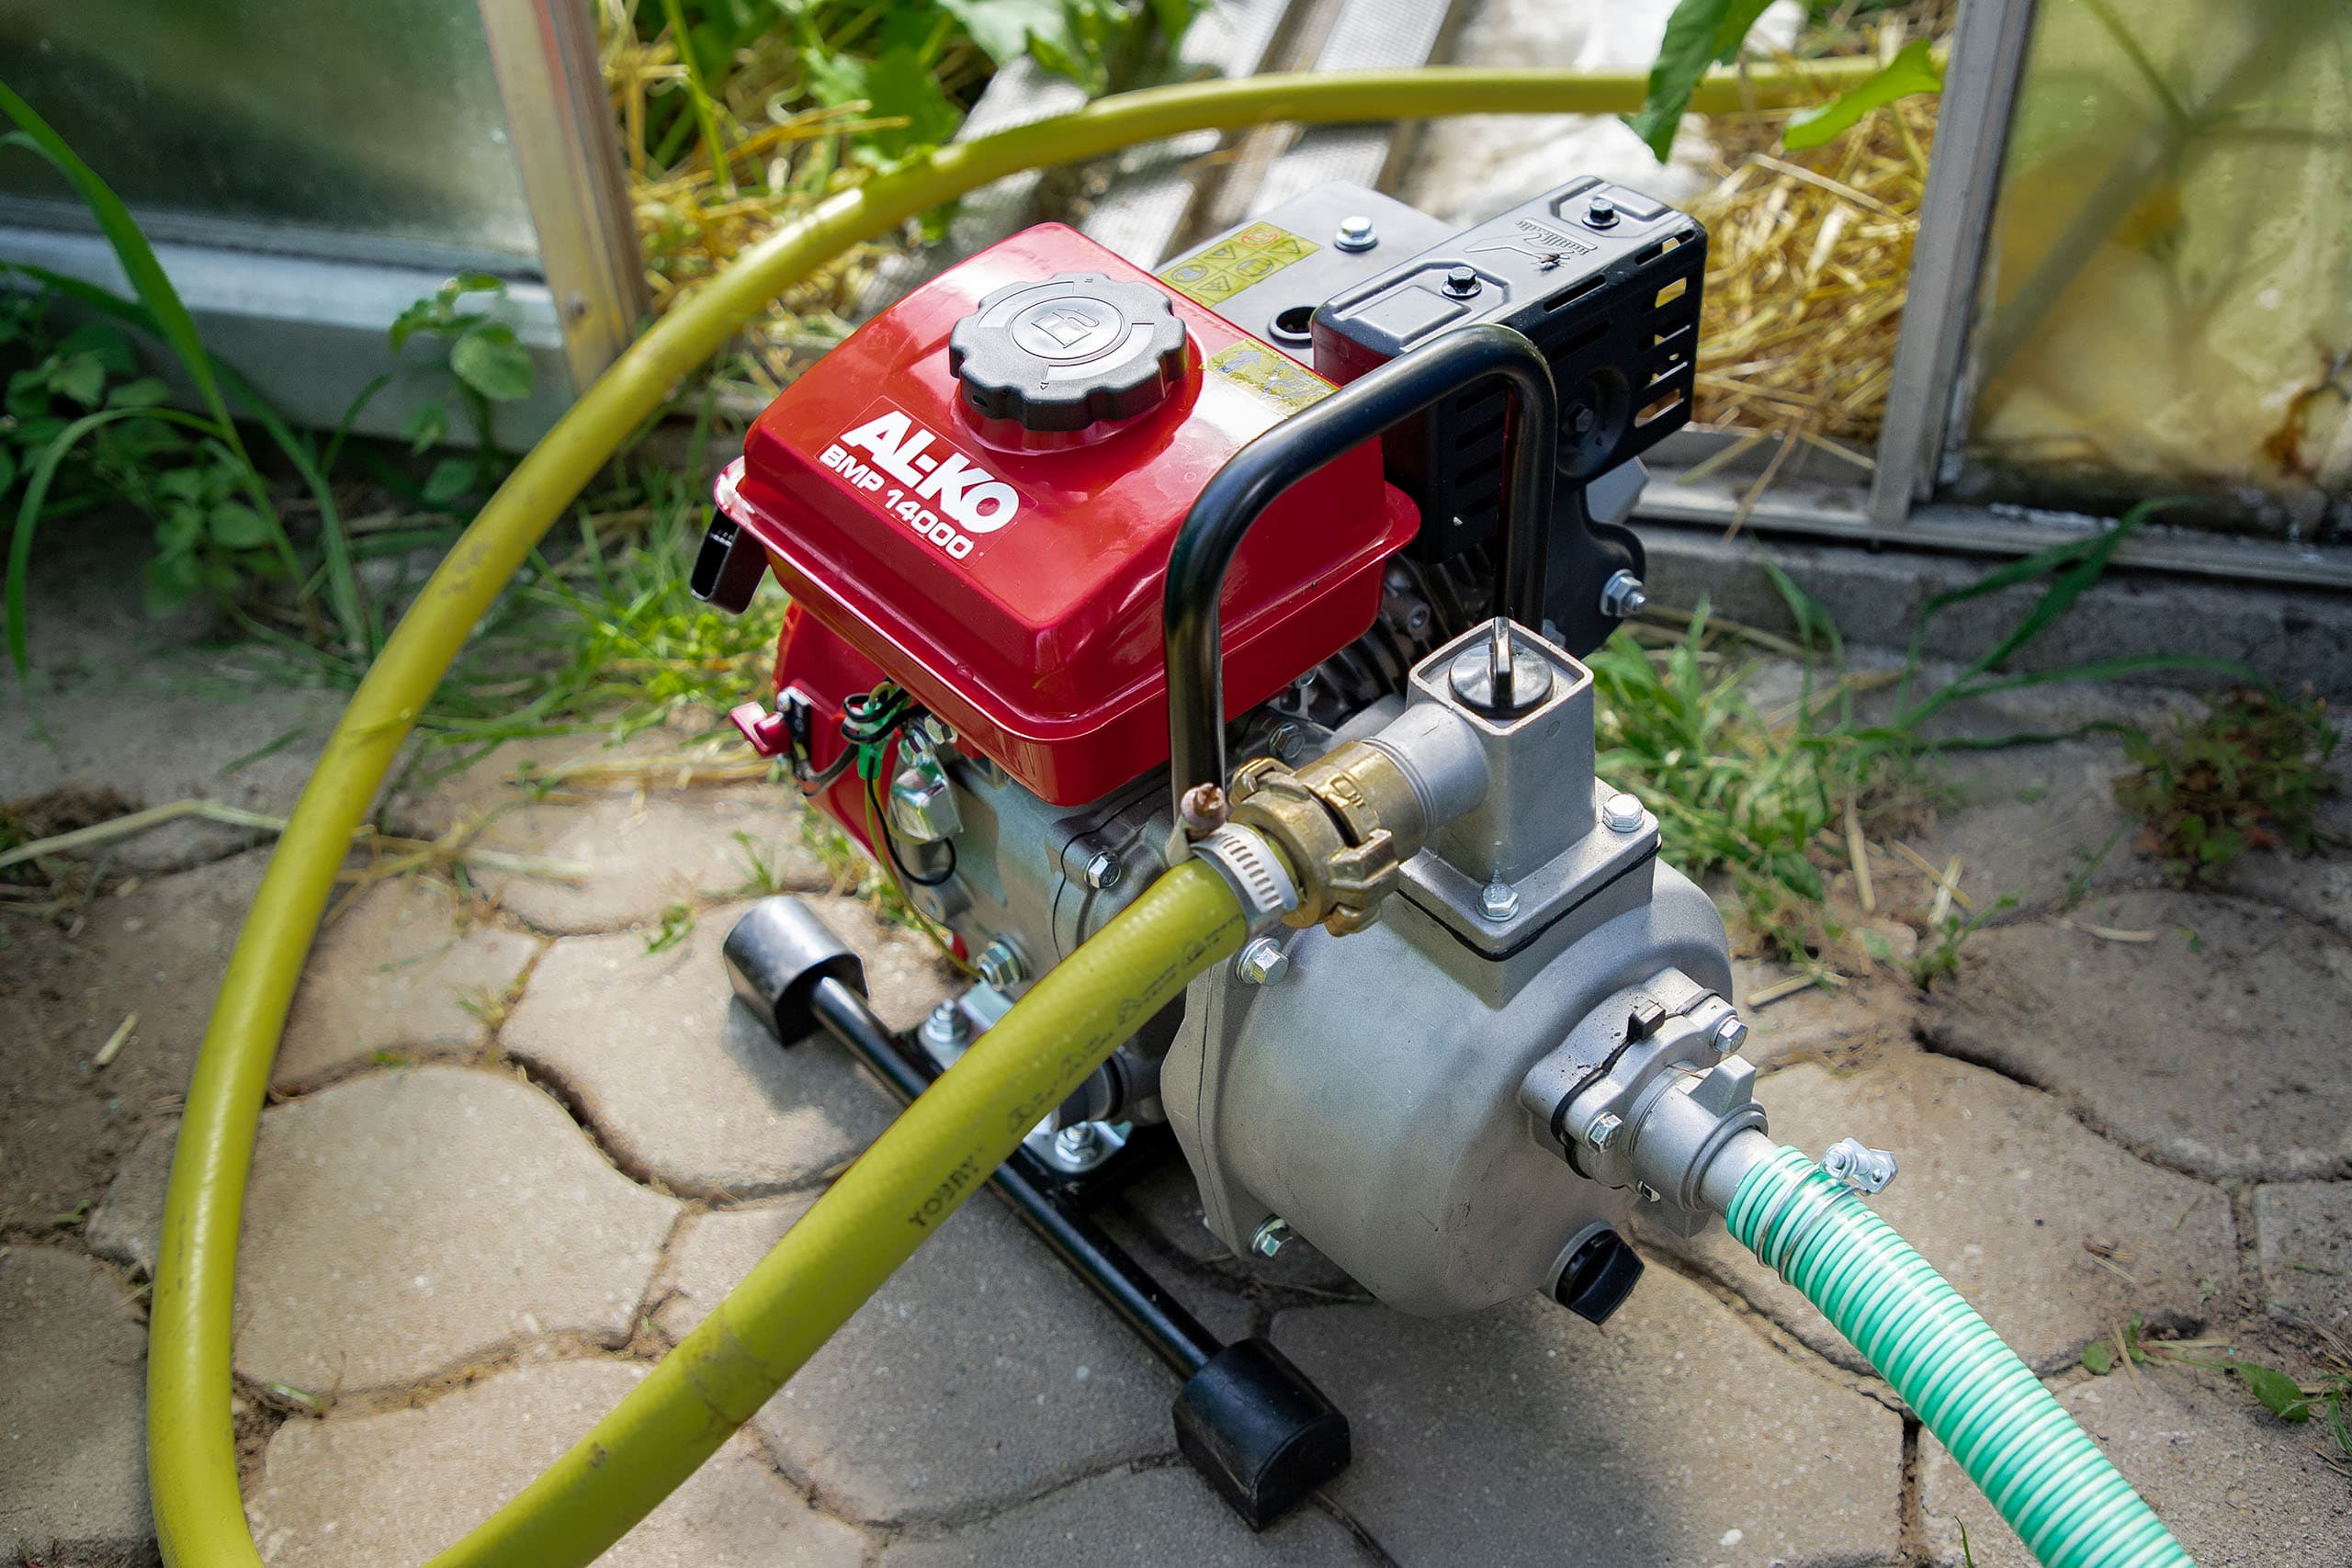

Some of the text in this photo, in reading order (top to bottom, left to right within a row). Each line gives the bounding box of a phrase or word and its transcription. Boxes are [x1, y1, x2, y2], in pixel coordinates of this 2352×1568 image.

[820, 444, 974, 559] BMP 14000
[840, 411, 1019, 533] AL-KO
